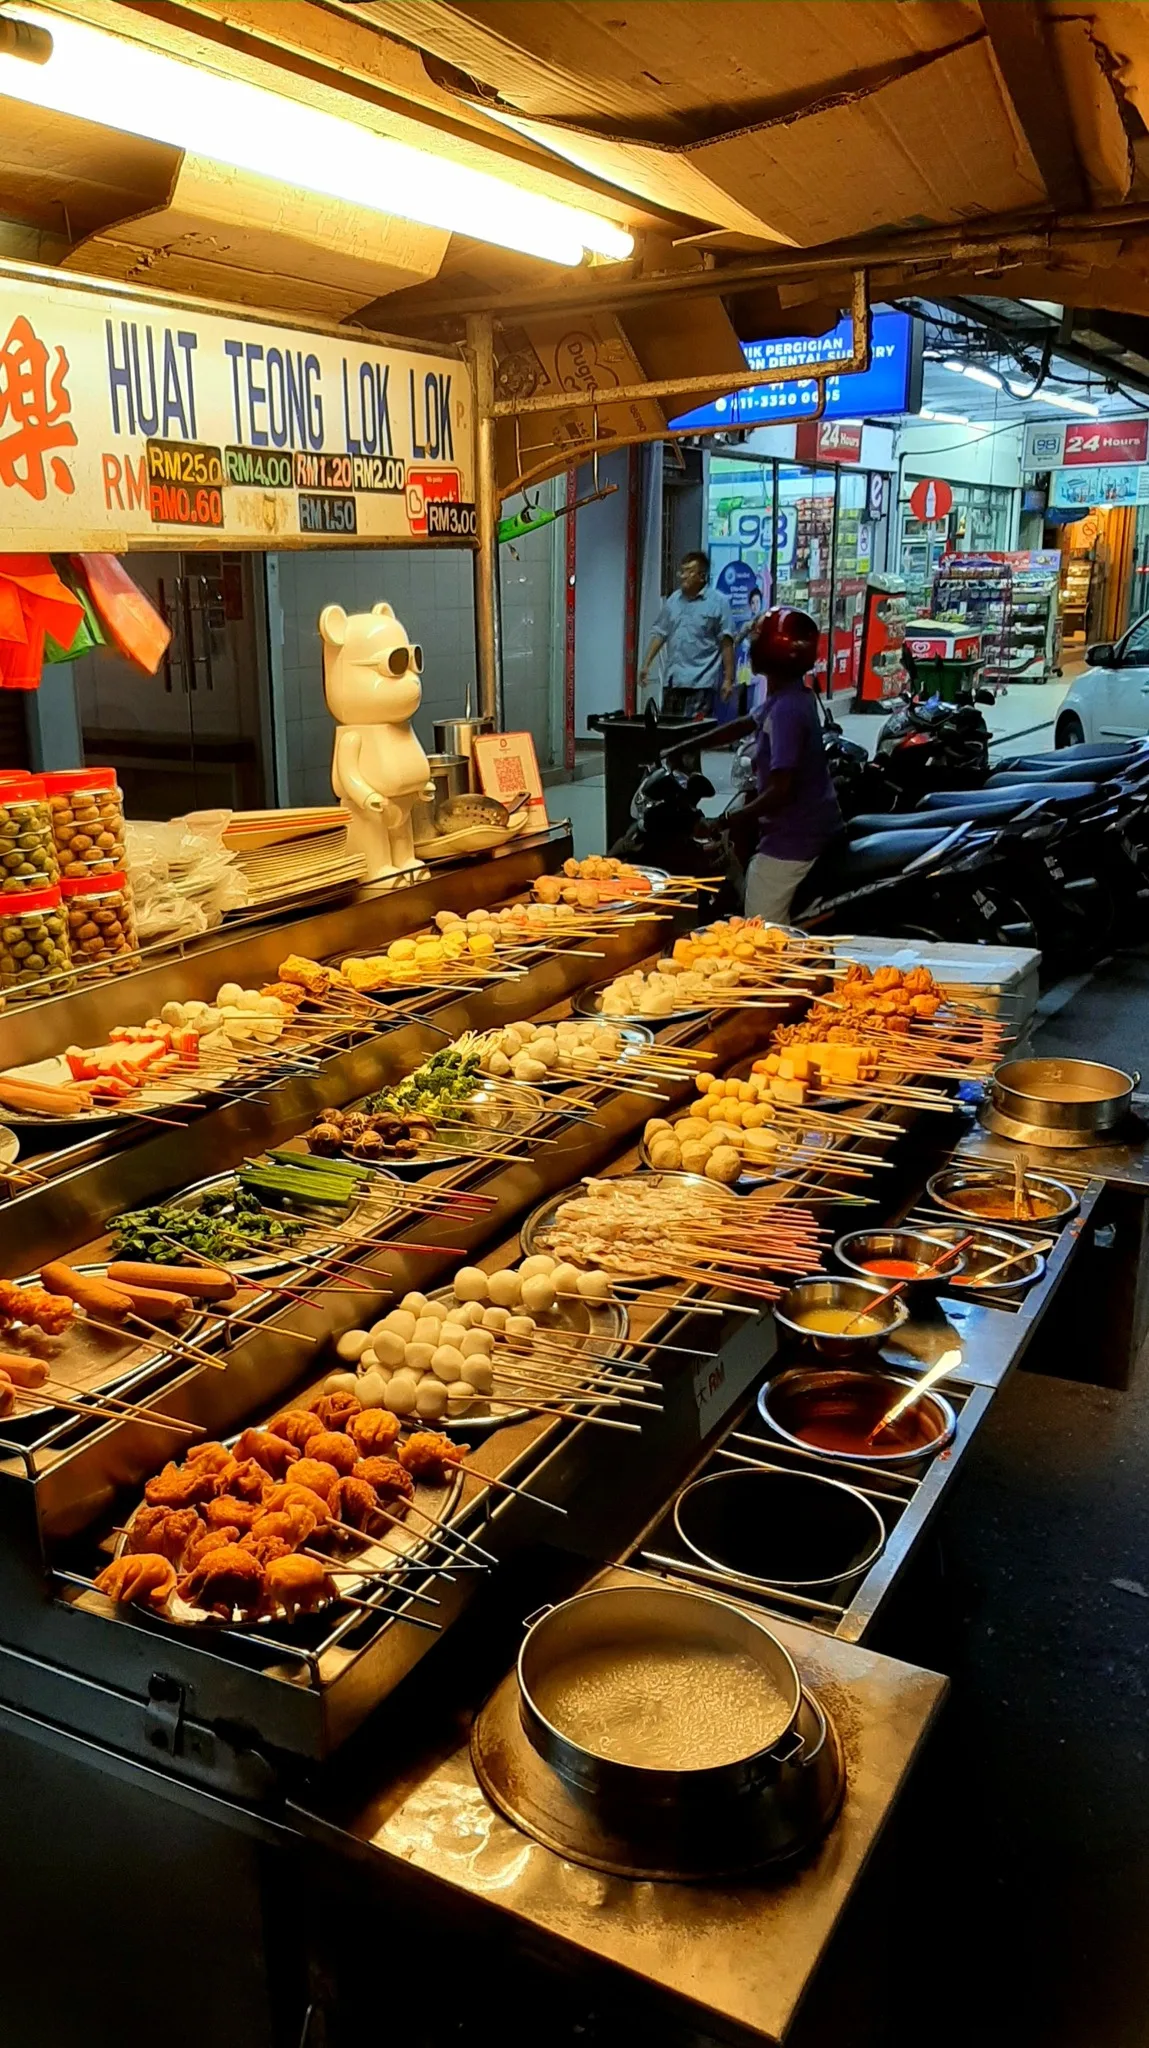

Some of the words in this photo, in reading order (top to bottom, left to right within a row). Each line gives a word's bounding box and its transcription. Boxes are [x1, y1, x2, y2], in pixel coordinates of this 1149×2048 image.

[765, 337, 843, 357] PERGIGIAN
[769, 353, 822, 368] DENTAL
[105, 319, 198, 439] HUAT
[224, 339, 325, 450] TEONG
[342, 357, 394, 456] LOK
[409, 368, 455, 461] LOK
[820, 421, 840, 448] 24
[841, 432, 859, 447] Hours
[1065, 434, 1101, 453] 24
[1103, 437, 1141, 447] Hours
[102, 453, 150, 511] RM
[225, 451, 291, 486] RM4.00
[297, 454, 352, 488] RM1.20
[354, 458, 404, 490] RM2.00
[150, 484, 222, 524] RM0.60
[300, 498, 355, 530] RM1.50
[429, 506, 477, 534] RM3.00
